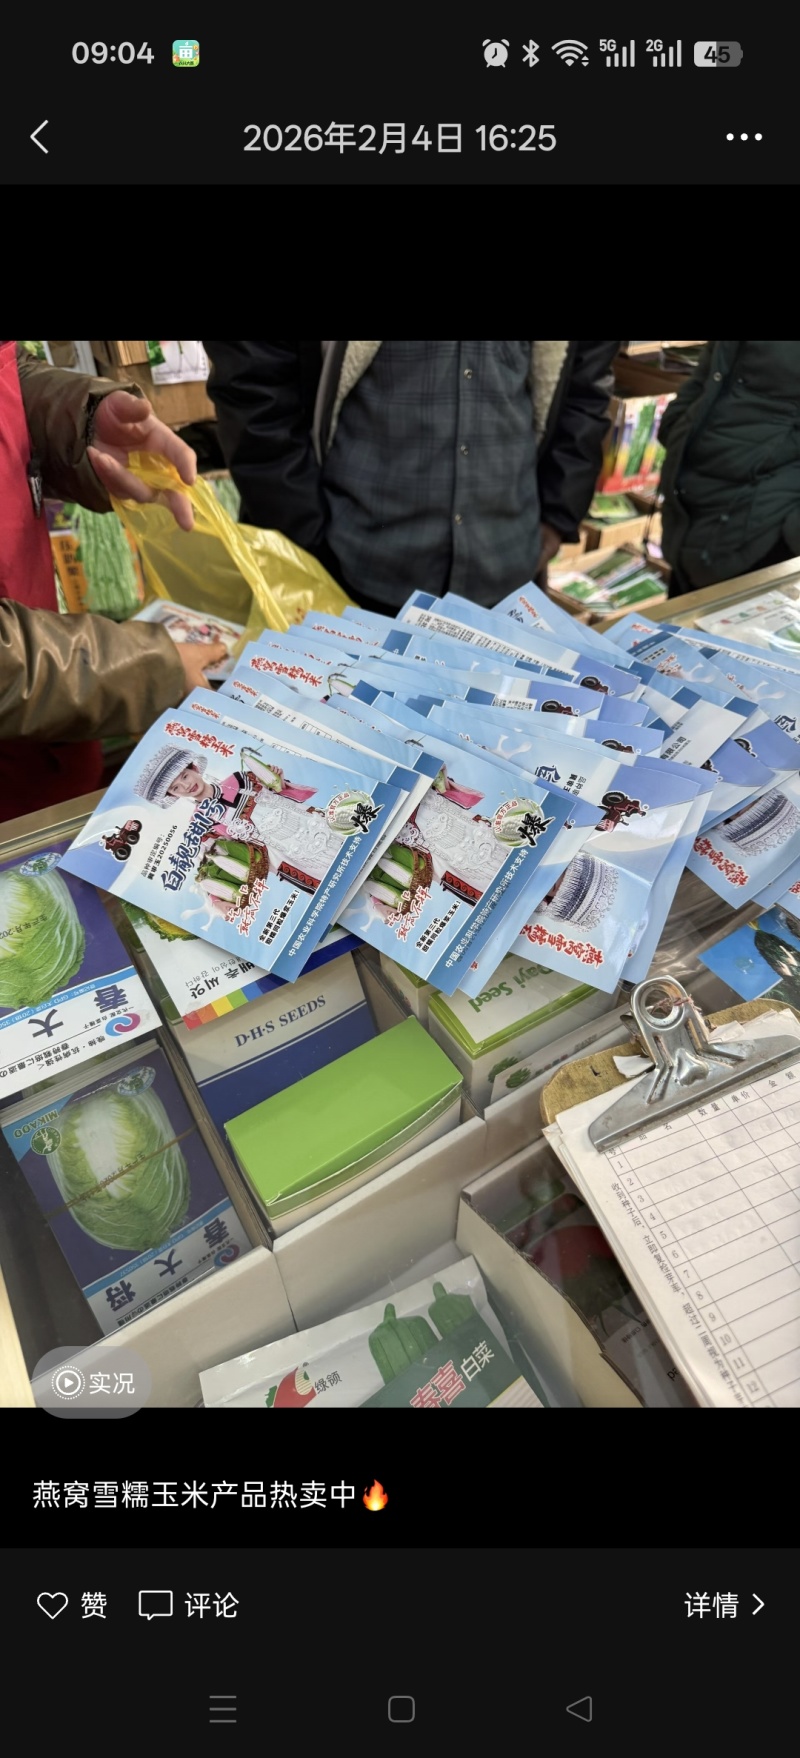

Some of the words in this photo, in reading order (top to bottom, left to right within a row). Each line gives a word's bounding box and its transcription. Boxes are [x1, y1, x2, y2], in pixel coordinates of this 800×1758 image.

[164, 720, 236, 758] 燕窝雪糯玉米
[160, 797, 228, 893] 白靓甜1号
[288, 835, 363, 958] 中国农业科学院特产研究所技术支持
[189, 977, 221, 1000] 씨앗
[468, 981, 514, 1013] Seed
[278, 994, 327, 1028] SEEDS
[697, 1100, 722, 1118] 数量
[13, 1108, 60, 1140] MIKADO
[616, 1159, 624, 1169] 1
[626, 1177, 634, 1186] 2
[637, 1194, 645, 1203] 3
[649, 1211, 656, 1221] 4
[659, 1230, 667, 1240] 5
[671, 1249, 679, 1259] 6
[683, 1269, 690, 1279] 7
[695, 1290, 704, 1301] 8
[708, 1312, 716, 1322] 9
[719, 1334, 732, 1346] 10
[460, 1339, 495, 1382] 白菜
[732, 1356, 746, 1369] 11
[314, 1369, 343, 1395] 绿领
[746, 1381, 760, 1394] 12
